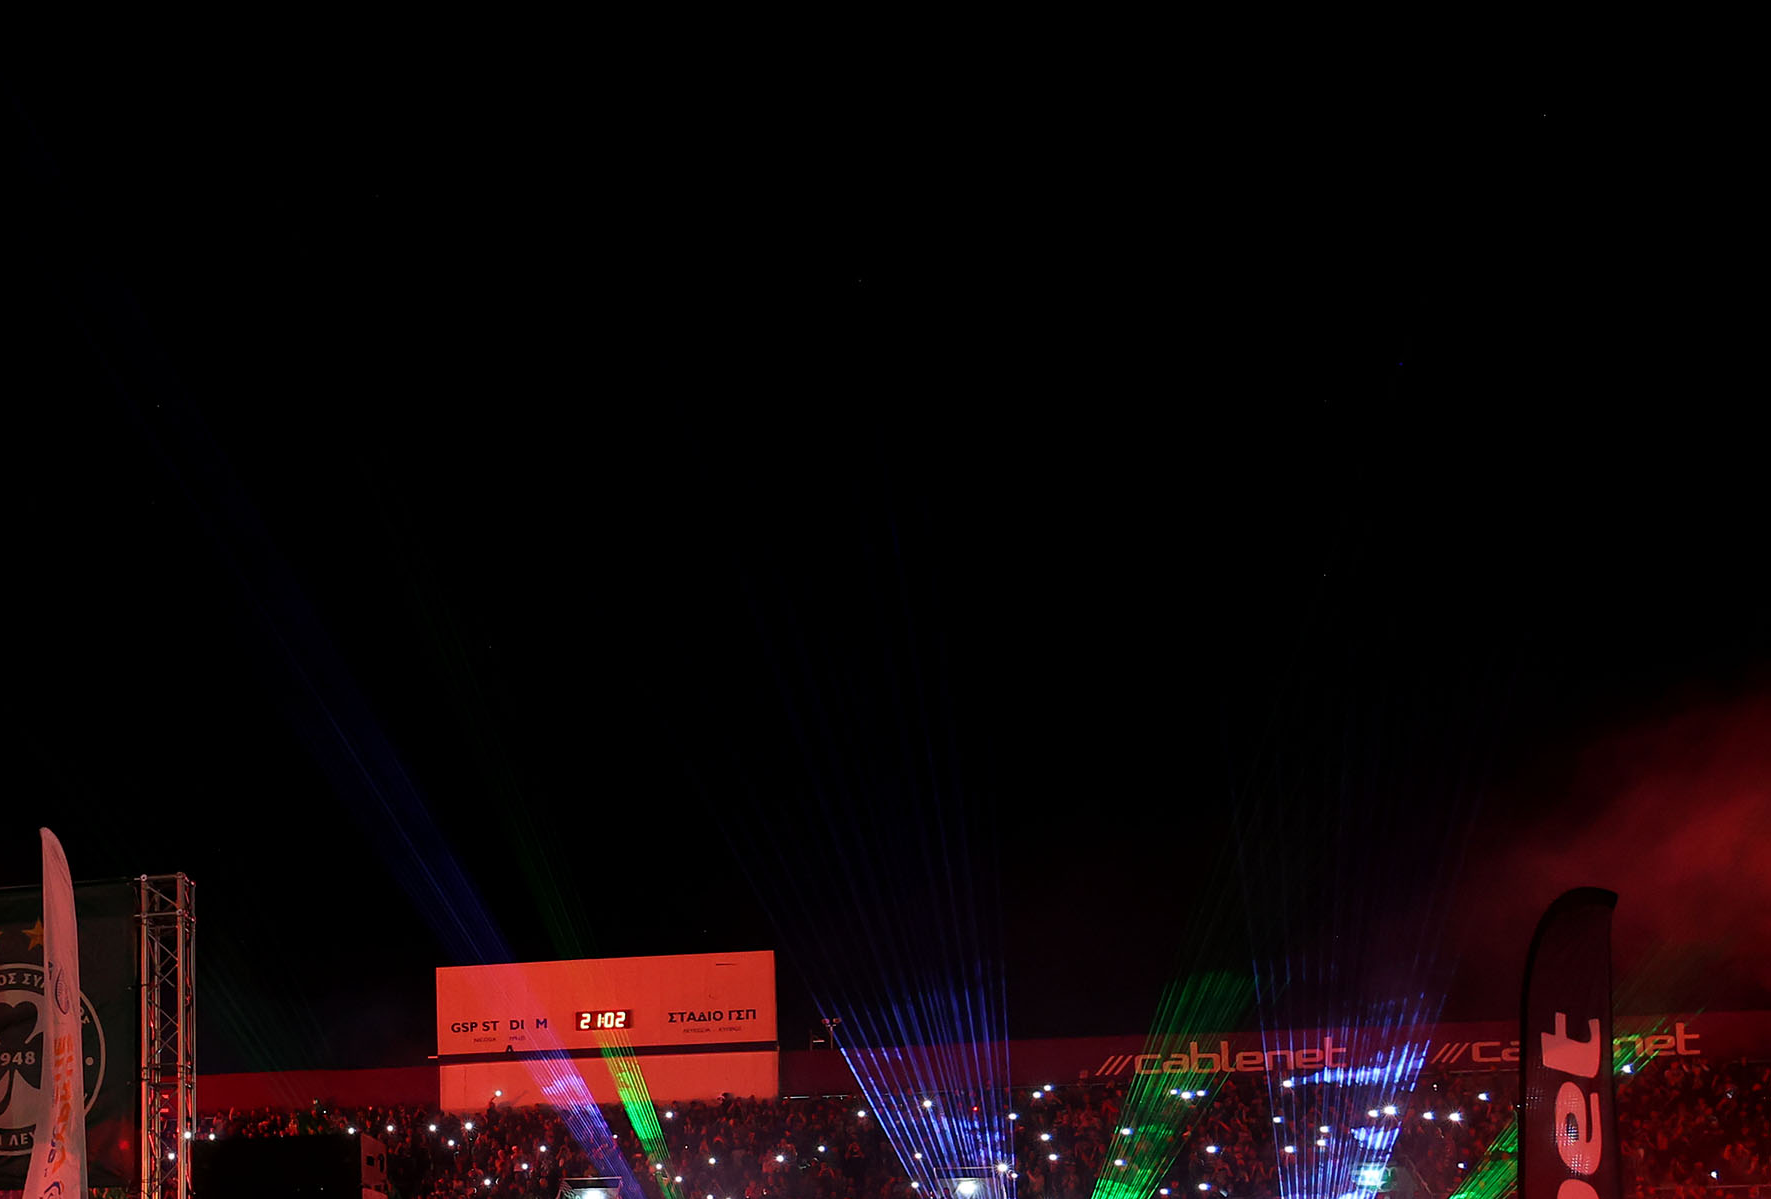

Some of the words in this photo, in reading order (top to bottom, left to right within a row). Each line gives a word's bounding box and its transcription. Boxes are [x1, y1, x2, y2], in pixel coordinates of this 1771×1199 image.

[579, 1011, 627, 1030] 21:02
[667, 1011, 724, 1023] ΣΤΑΔΙΟ
[728, 1009, 757, 1020] ΓΣΠ
[451, 1021, 478, 1033] GSP
[1133, 1036, 1348, 1075] cablenet
